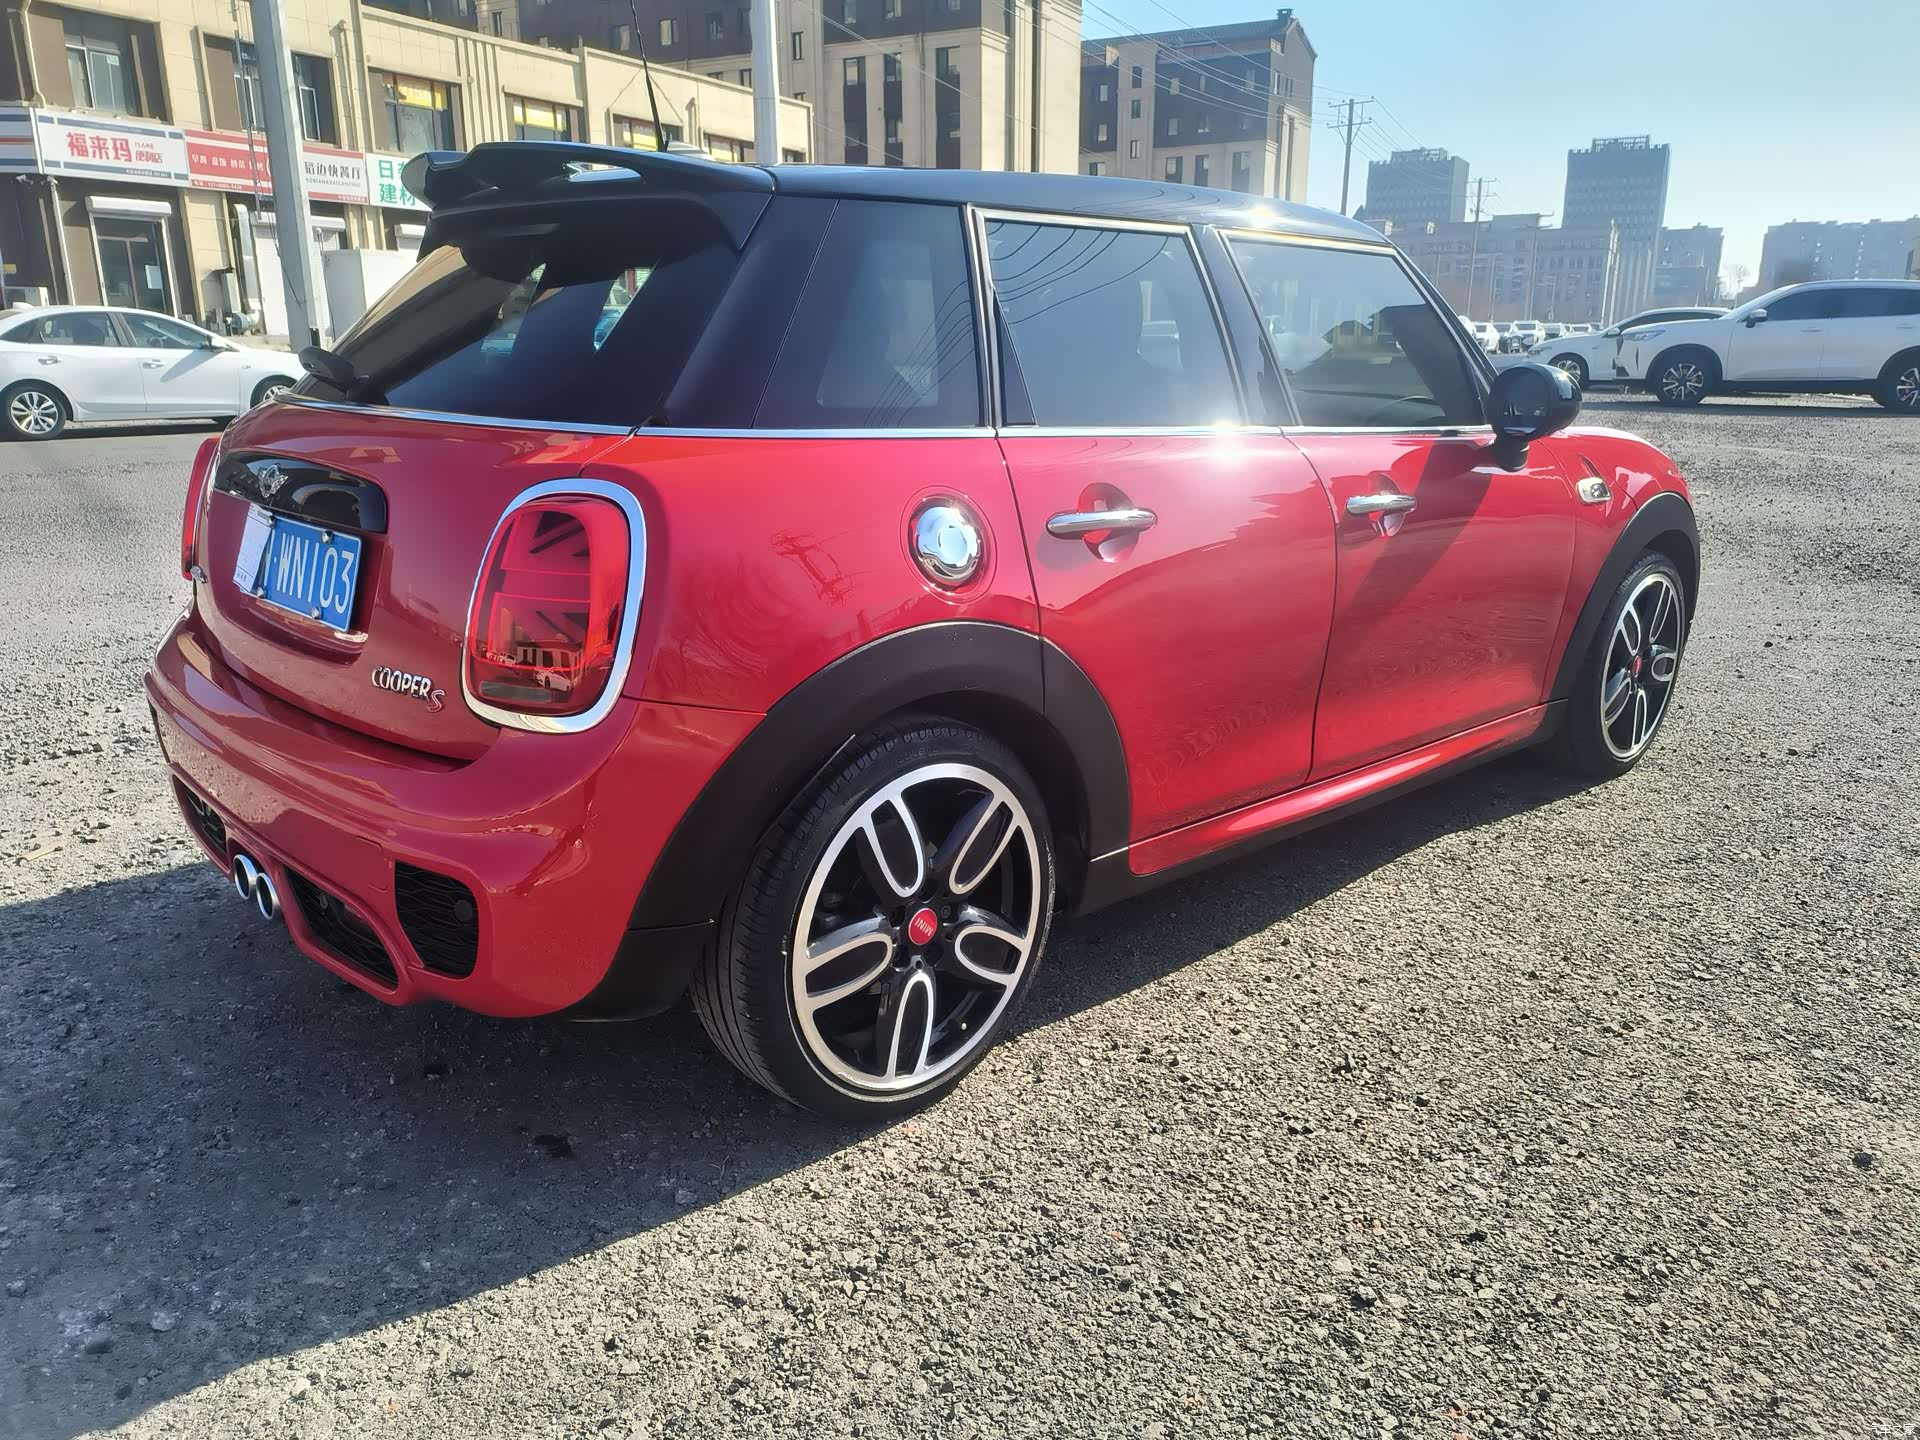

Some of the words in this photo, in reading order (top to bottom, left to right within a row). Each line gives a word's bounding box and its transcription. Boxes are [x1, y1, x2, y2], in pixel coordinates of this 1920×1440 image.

[66, 131, 132, 162] 福来玛
[135, 150, 163, 164] 便利店
[378, 183, 416, 206] 建材
[371, 666, 431, 702] COOPER
[426, 689, 445, 713] S
[914, 917, 934, 937] MINI
